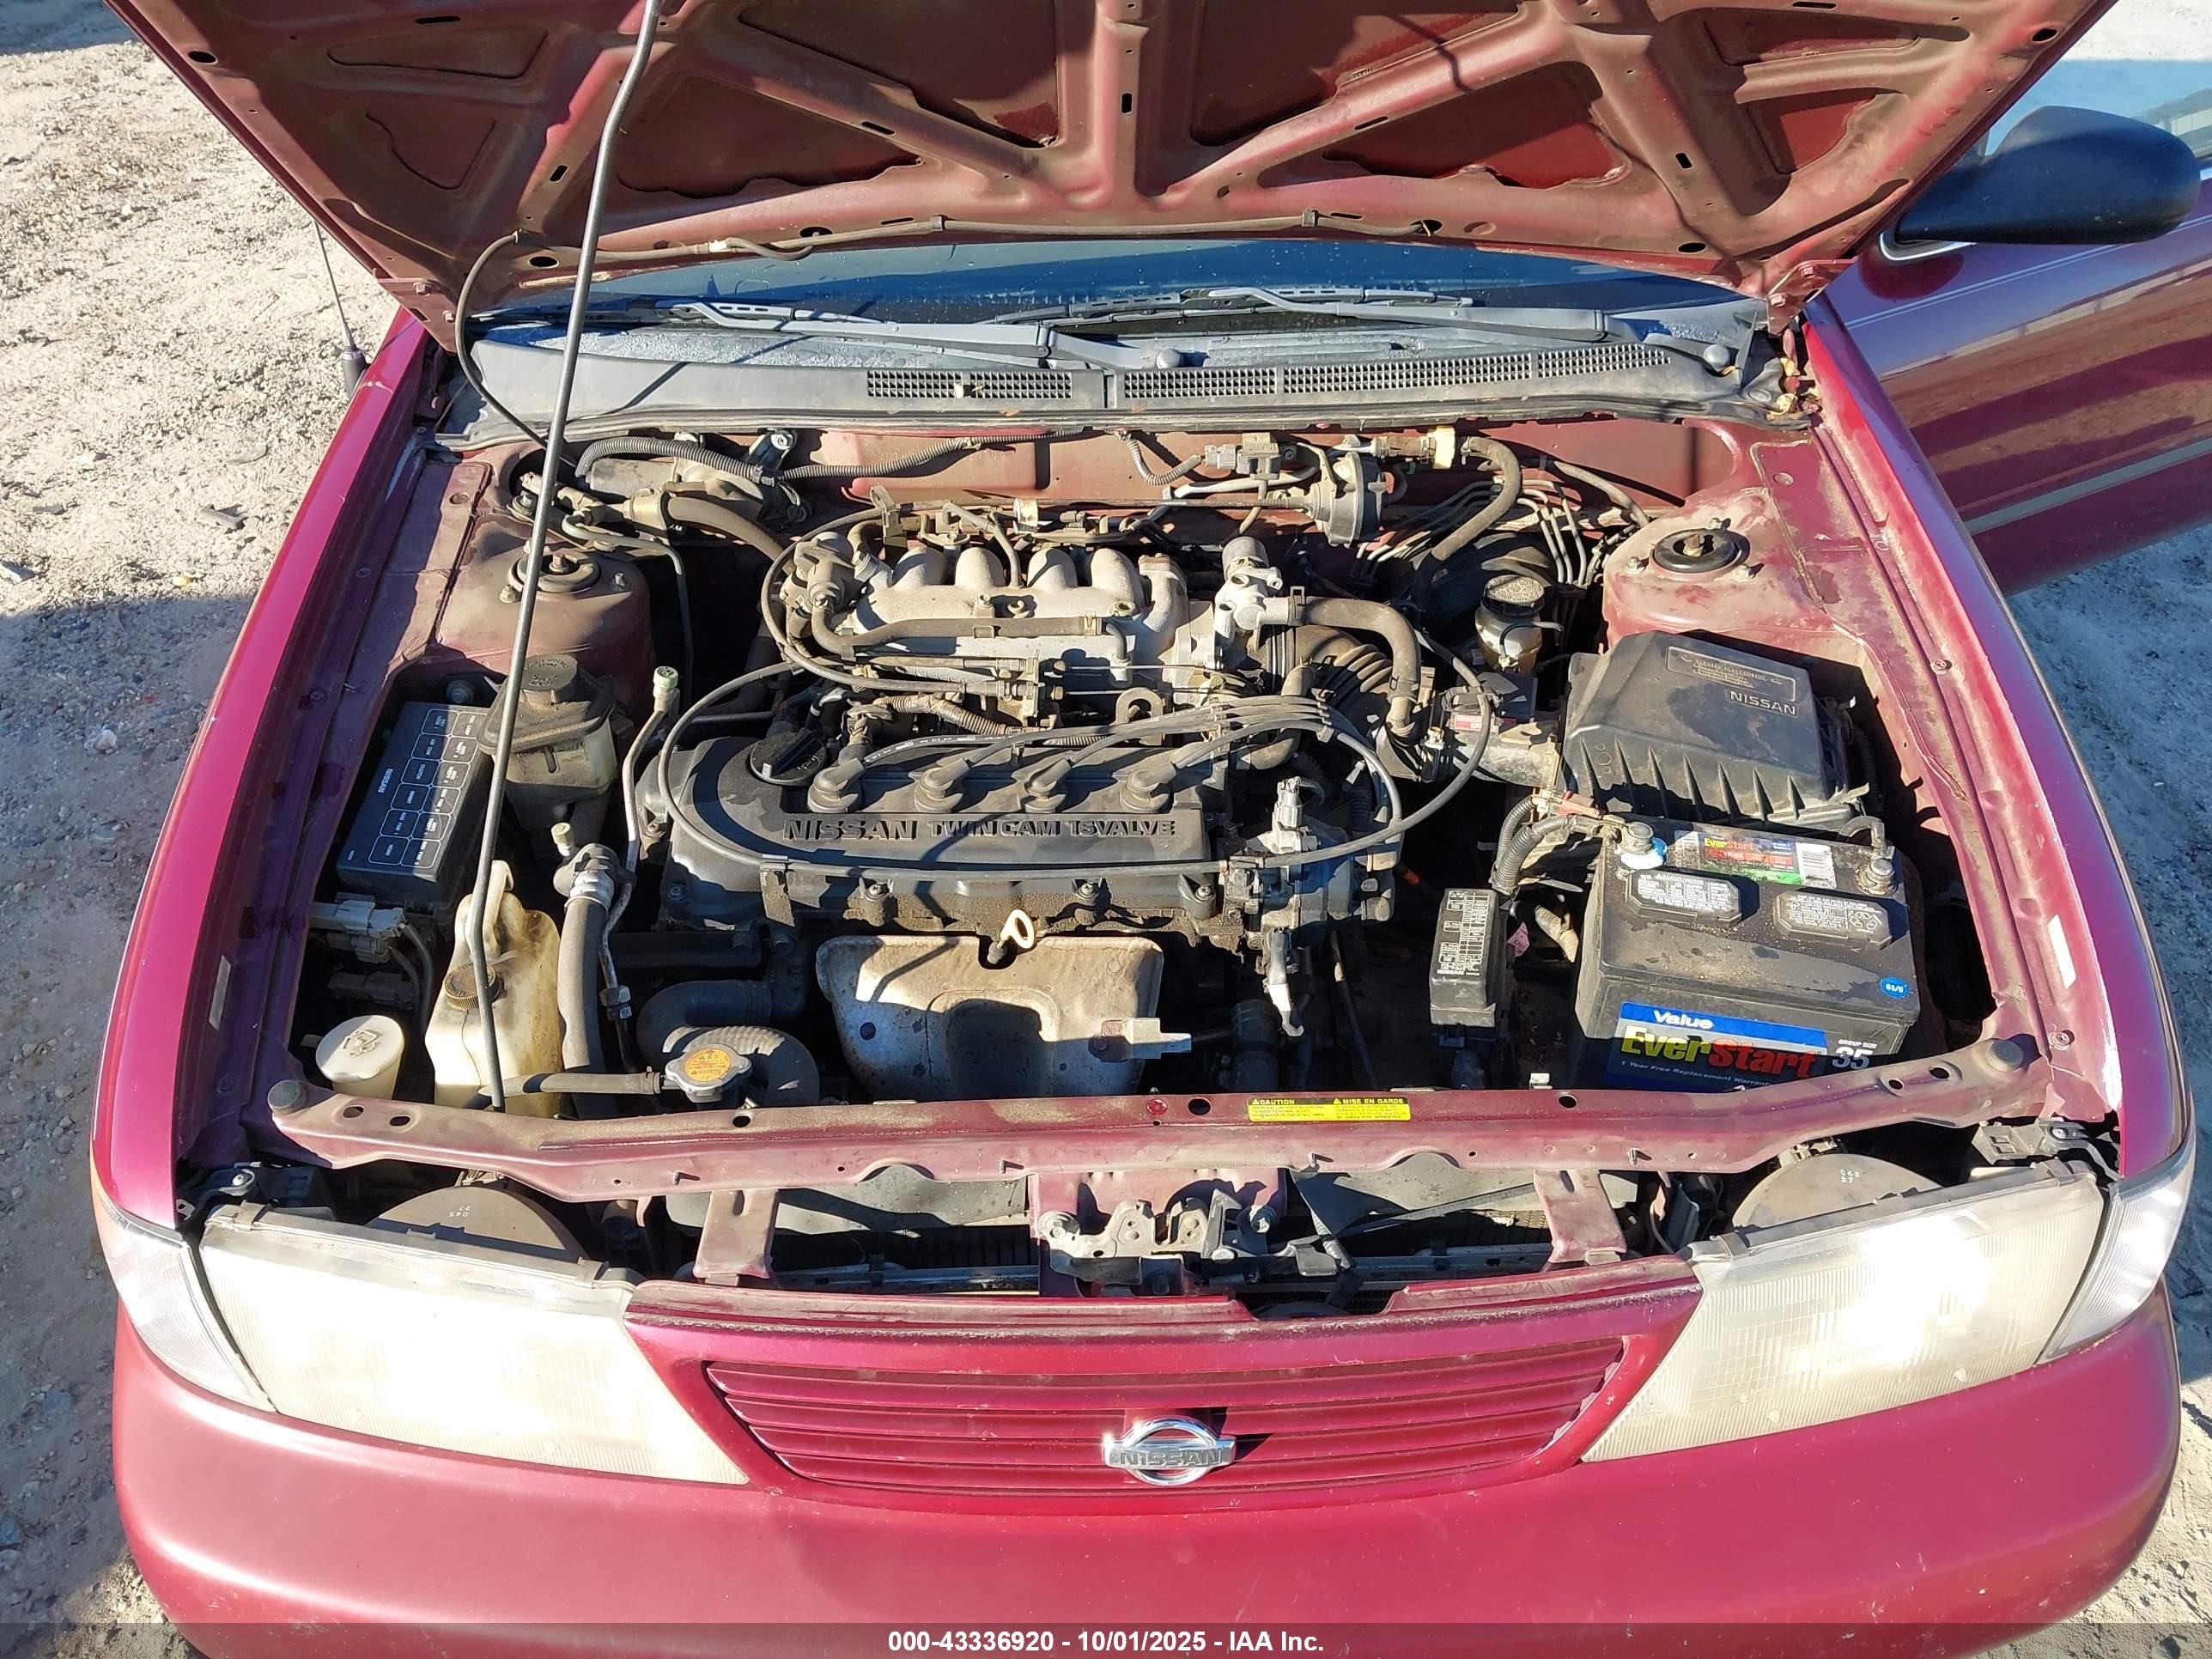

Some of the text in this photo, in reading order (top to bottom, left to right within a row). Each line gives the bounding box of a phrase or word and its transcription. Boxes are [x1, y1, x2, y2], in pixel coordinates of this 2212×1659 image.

[1729, 690, 1796, 715] NISSAN
[378, 769, 394, 793] NISSAN
[782, 819, 918, 841] NISSAN
[927, 820, 1000, 836] TWIN
[1001, 820, 1062, 836] CAM
[1704, 837, 1753, 851] EverStart
[1653, 1010, 1714, 1030] Value
[1620, 1024, 1820, 1079] EverStart
[1838, 1038, 1878, 1049] GROUP SIZE
[1831, 1046, 1874, 1070] 35
[1629, 1061, 1649, 1070] Year
[1673, 1067, 1732, 1082] Replacement
[1119, 1449, 1222, 1467] NISSAN
